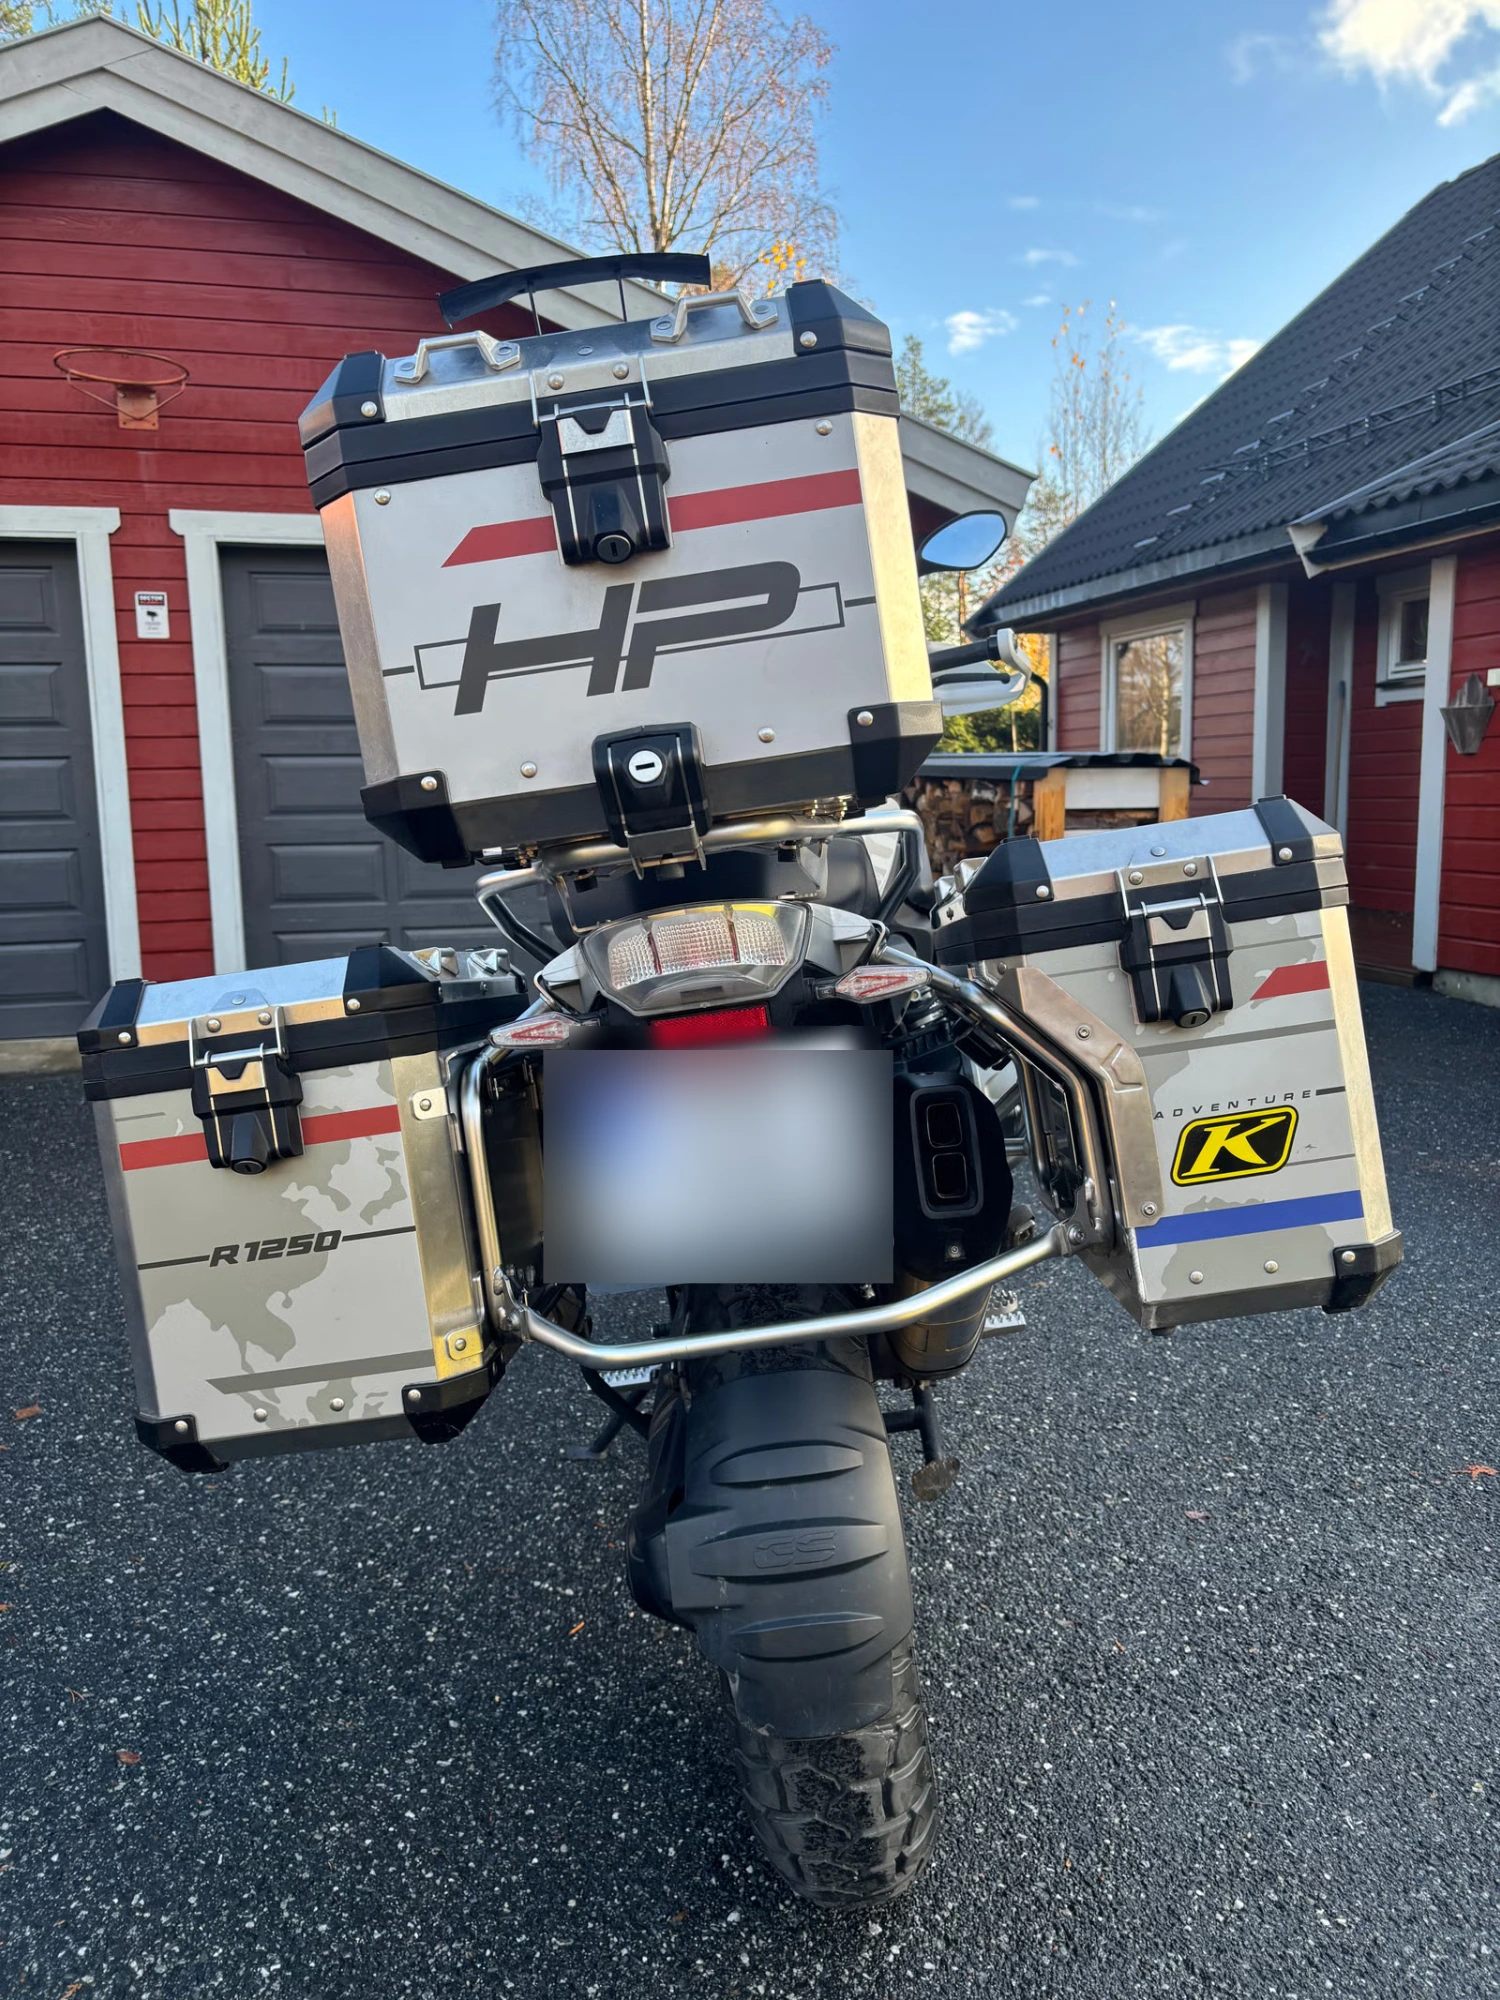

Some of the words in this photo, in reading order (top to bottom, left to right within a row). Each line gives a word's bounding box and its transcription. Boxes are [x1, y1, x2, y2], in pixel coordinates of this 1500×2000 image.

[454, 560, 801, 716] HP
[1153, 1089, 1311, 1120] ADVENTURE
[1181, 1115, 1287, 1177] K
[209, 1244, 240, 1267] R
[244, 1229, 342, 1262] 1250
[752, 1530, 837, 1569] GS
